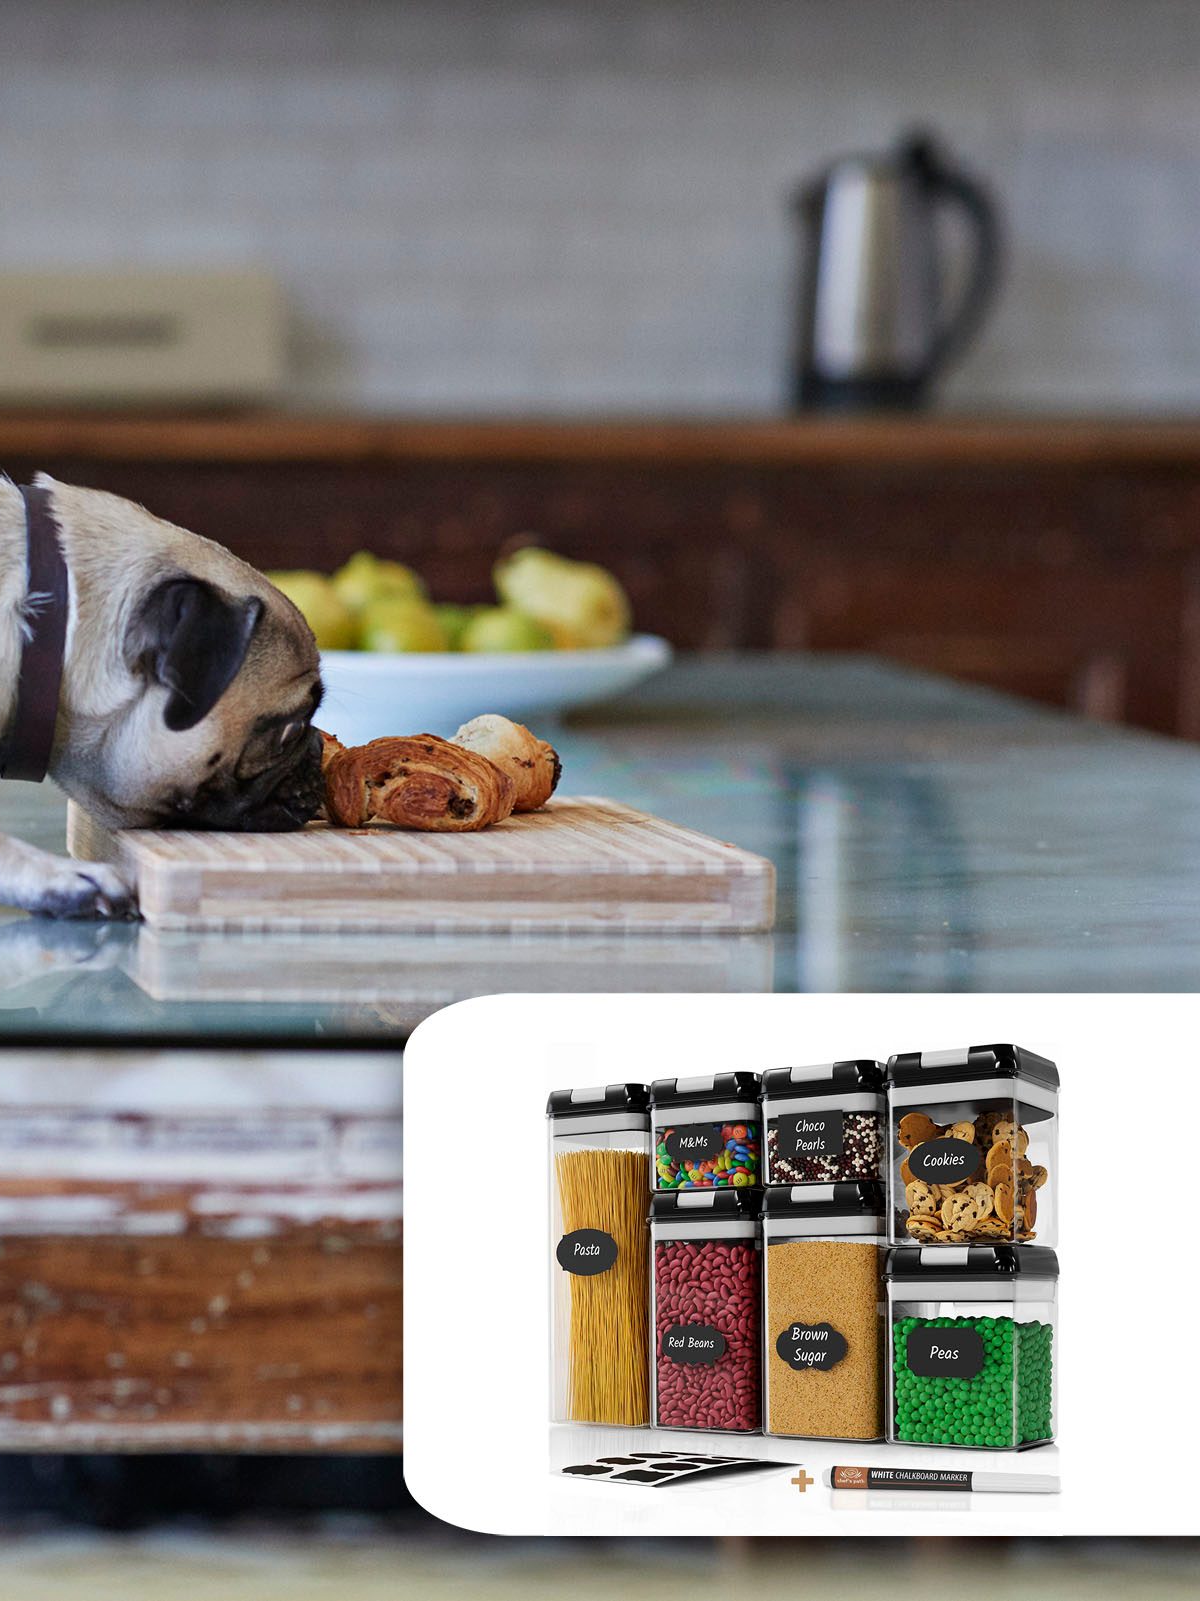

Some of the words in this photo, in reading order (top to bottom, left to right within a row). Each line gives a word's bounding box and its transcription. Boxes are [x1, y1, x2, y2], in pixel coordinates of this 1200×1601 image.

[795, 1119, 825, 1134] Choco
[679, 1135, 708, 1149] M&Ms
[795, 1137, 826, 1151] Pearls
[923, 1152, 965, 1167] Cookies
[573, 1242, 601, 1256] Pasta
[791, 1327, 829, 1342] Brown
[668, 1336, 686, 1348] Red
[687, 1336, 715, 1349] Beans
[793, 1348, 827, 1365] Sugar
[929, 1345, 960, 1361] Peas
[871, 1470, 894, 1480] WHITE
[895, 1472, 939, 1481] CHALKBOARD
[939, 1473, 968, 1482] MARKER
